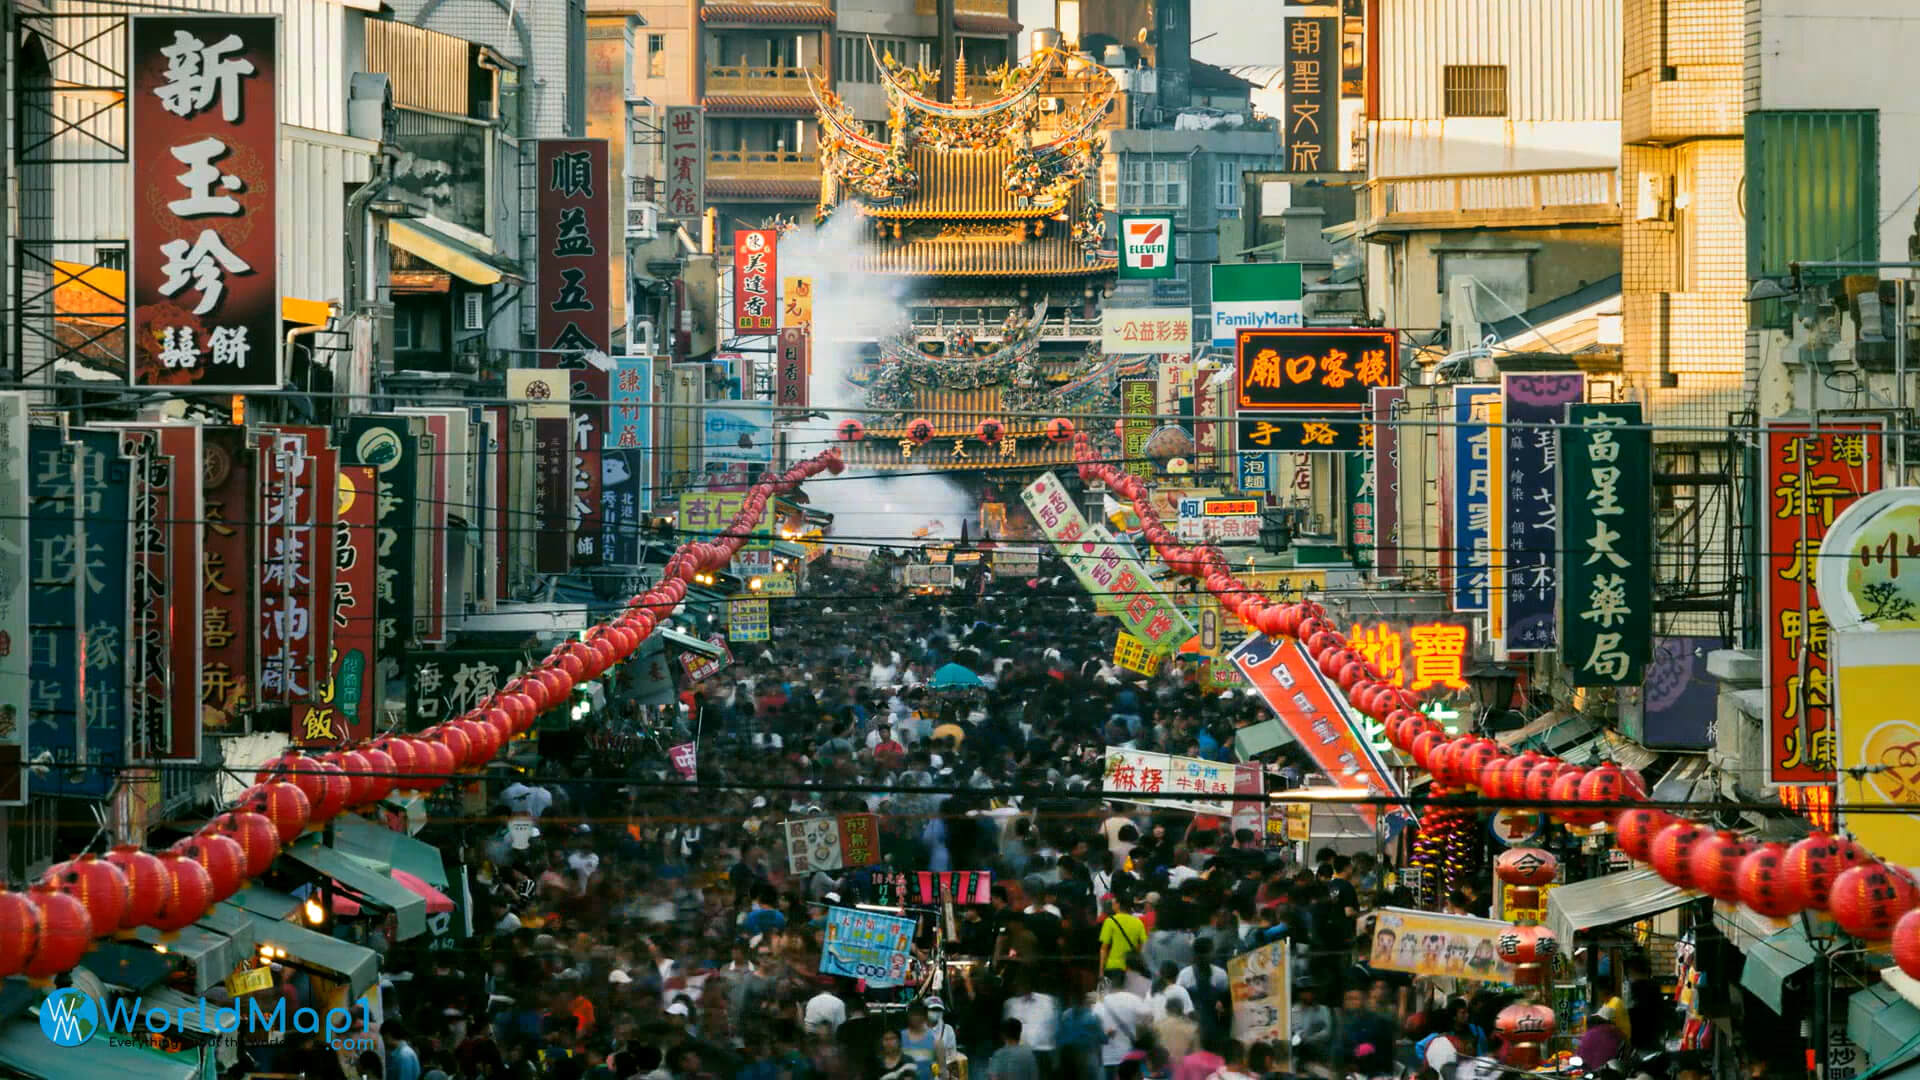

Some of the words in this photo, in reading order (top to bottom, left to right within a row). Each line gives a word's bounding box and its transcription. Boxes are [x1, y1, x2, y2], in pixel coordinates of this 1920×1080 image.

[1291, 20, 1321, 171] 朝聖文旅
[154, 30, 254, 315] 新玉珍
[672, 112, 698, 215] 世一賓館
[551, 152, 600, 398] 順益五金
[744, 253, 767, 316] 美達香
[1123, 321, 1188, 341] 公益彩券
[1216, 311, 1300, 327] FamilyMart
[1246, 348, 1389, 389] 廟口客棧
